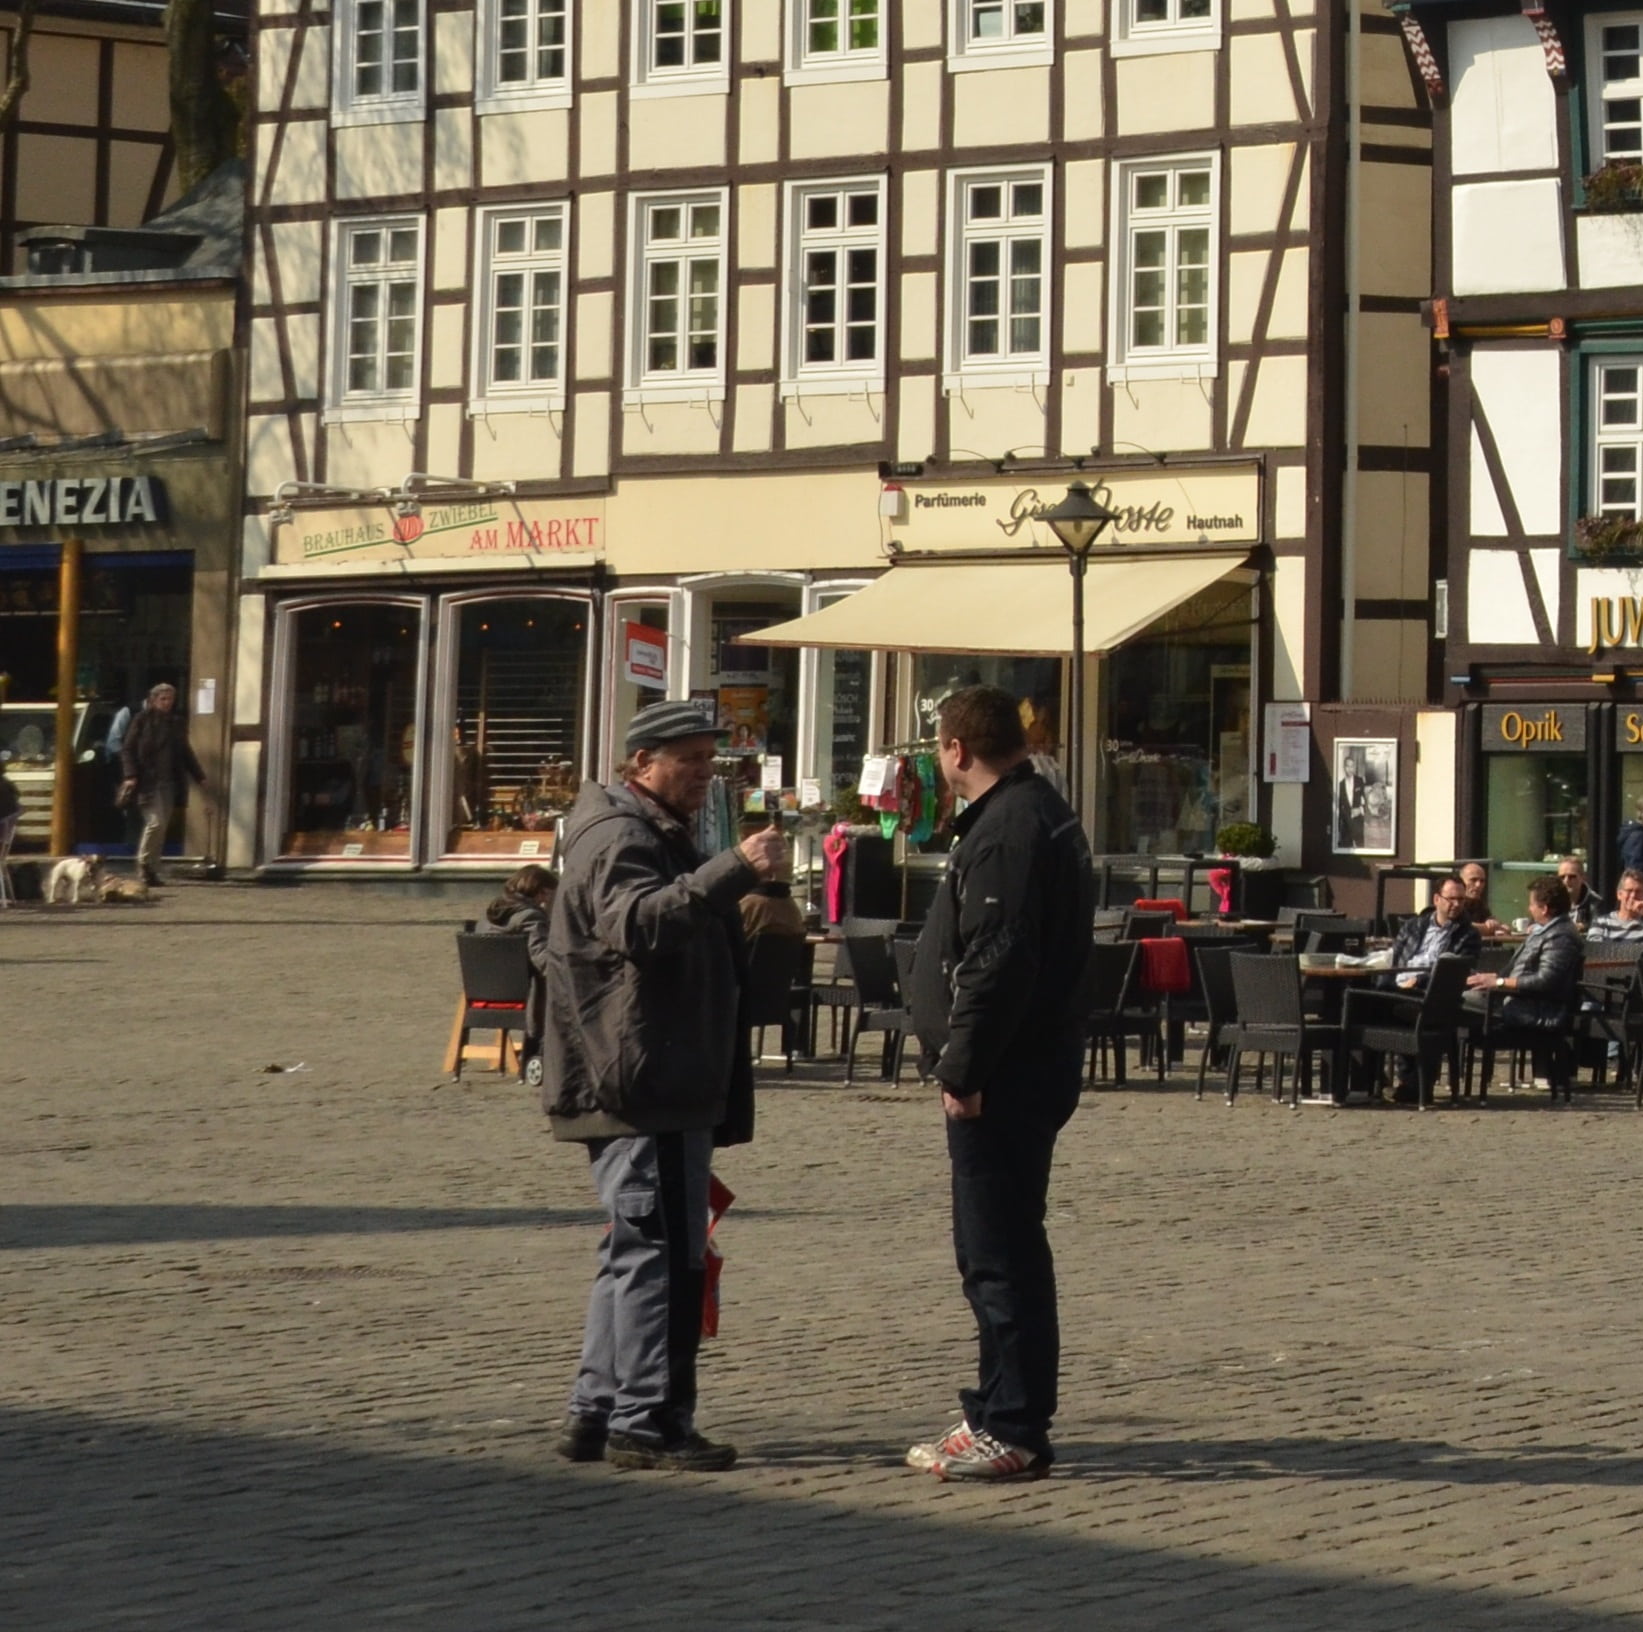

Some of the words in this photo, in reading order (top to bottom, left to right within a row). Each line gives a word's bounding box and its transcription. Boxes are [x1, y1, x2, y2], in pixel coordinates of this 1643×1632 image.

[914, 491, 987, 508] Parfümerie
[303, 523, 385, 553] BRAUHAUS
[428, 500, 499, 529] ZWIEBEL
[1185, 513, 1244, 531] Hautnah
[469, 528, 499, 550] AM
[505, 517, 600, 549] MARKT
[919, 698, 935, 713] 30
[1105, 738, 1120, 752] 30
